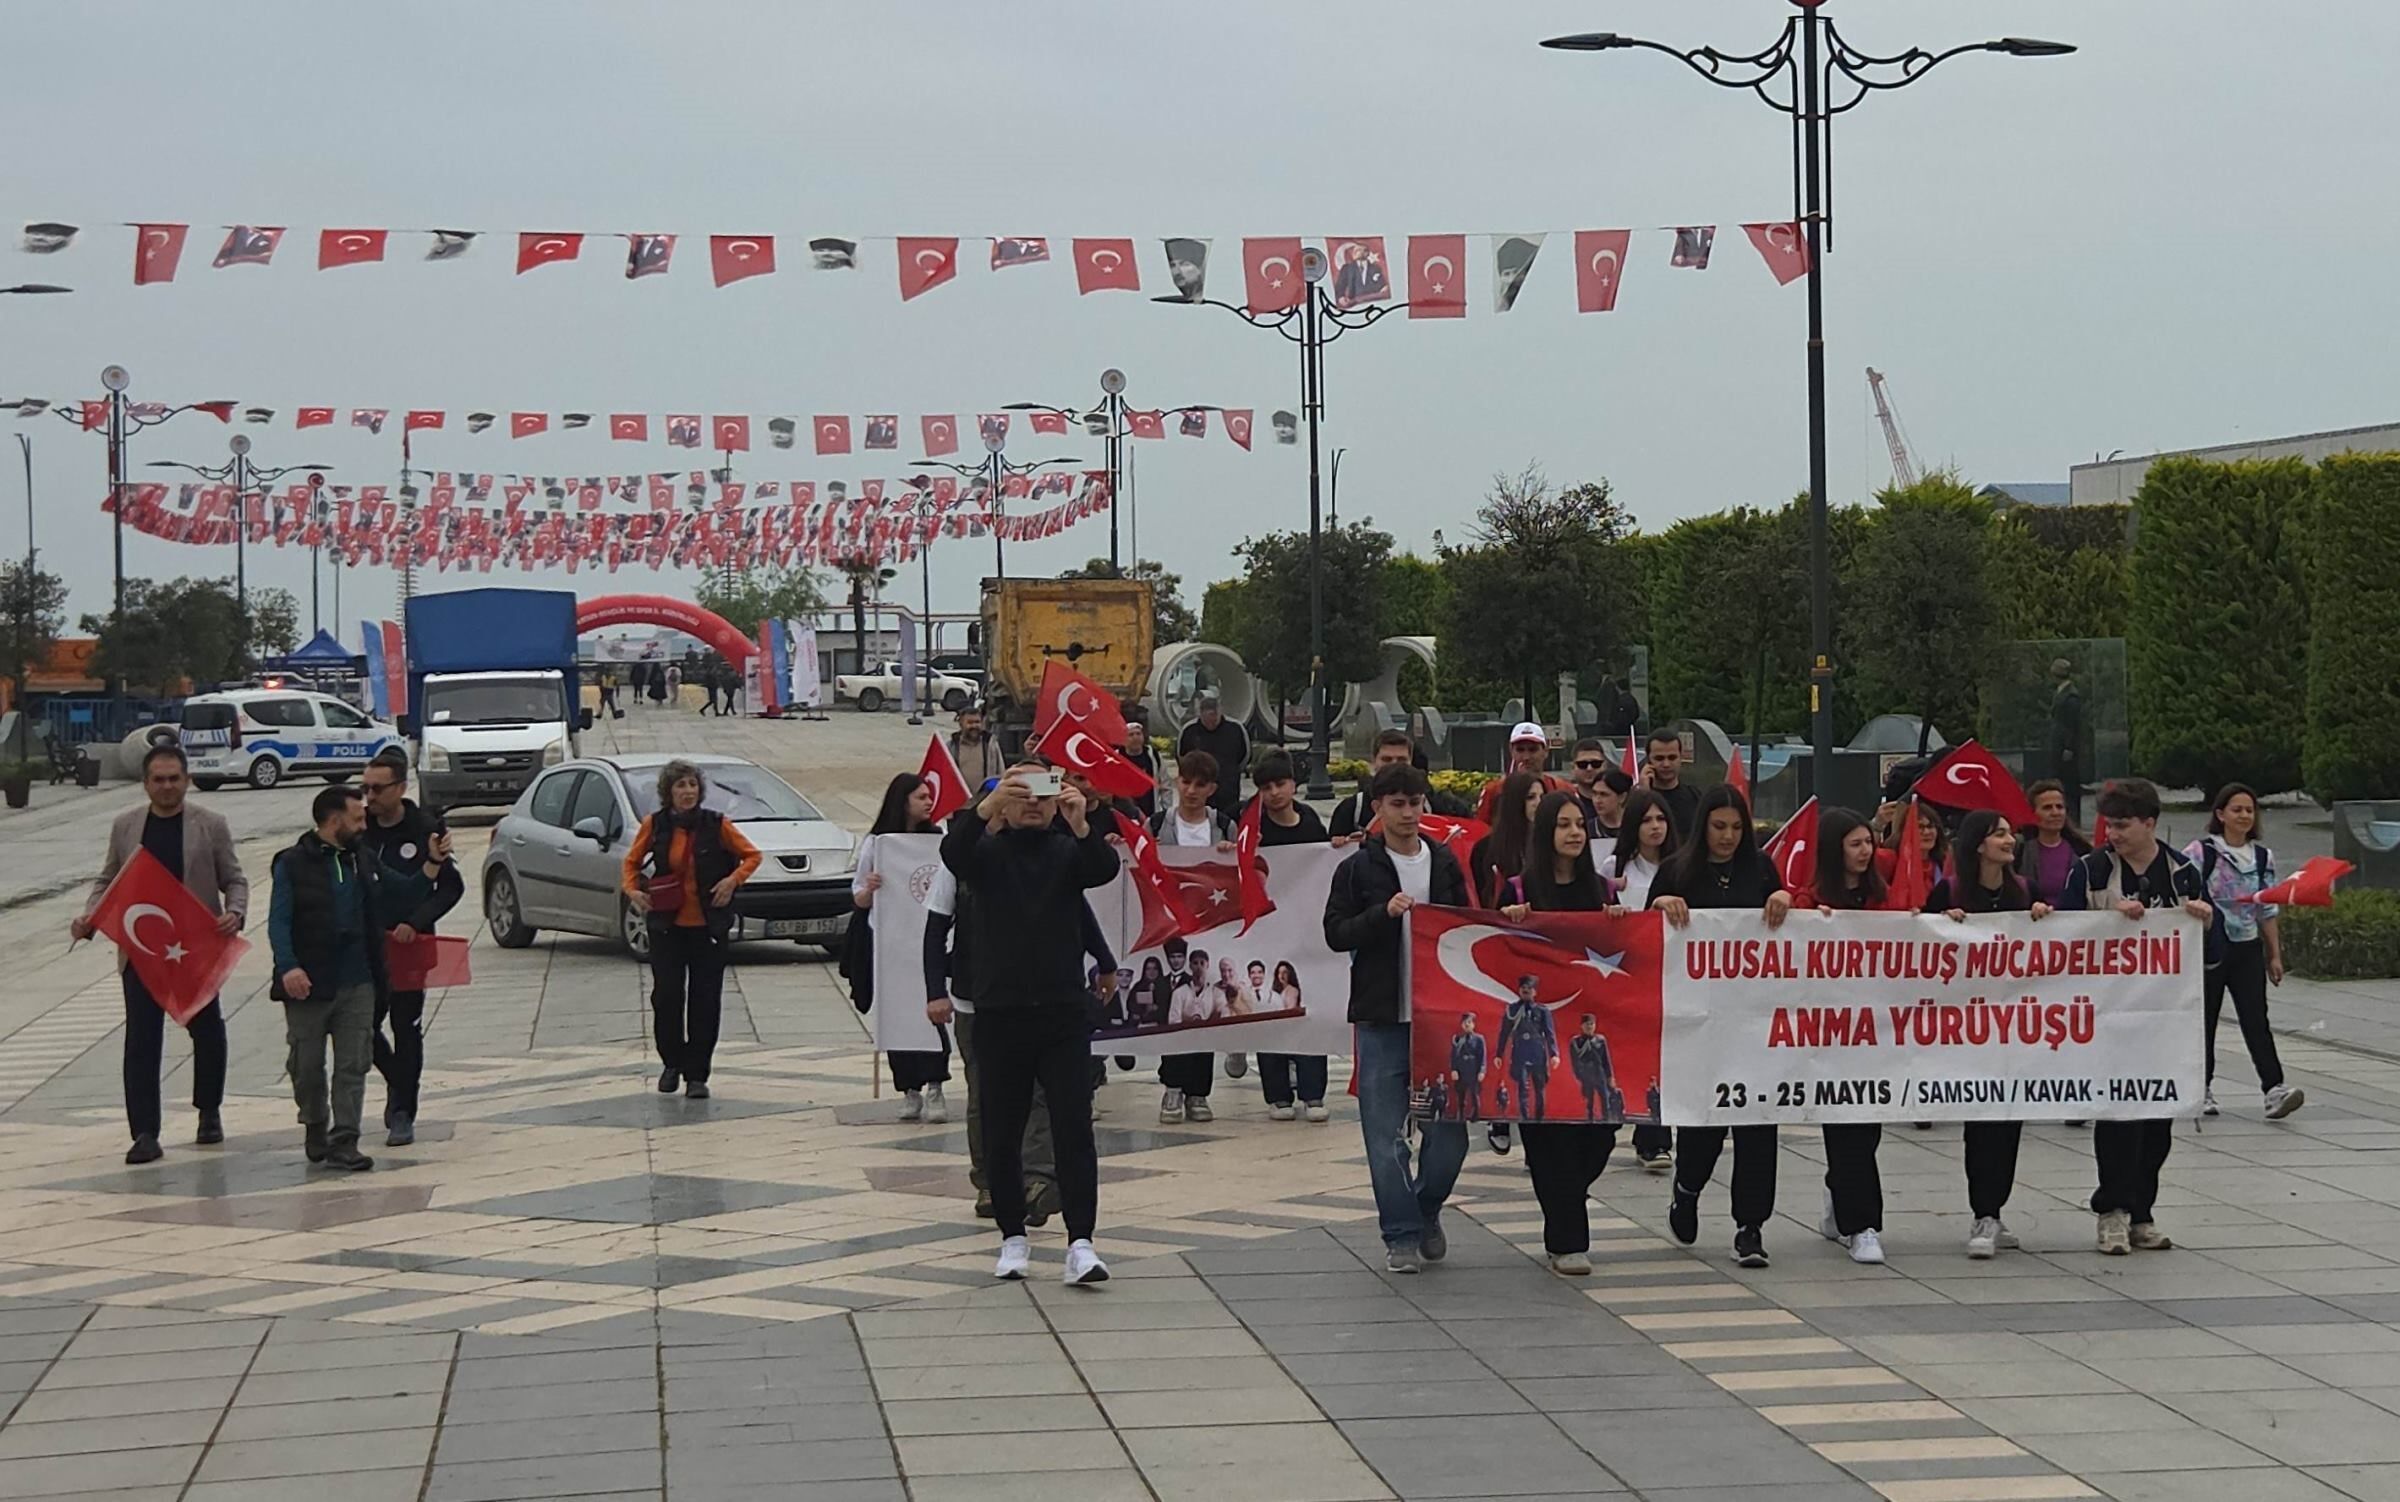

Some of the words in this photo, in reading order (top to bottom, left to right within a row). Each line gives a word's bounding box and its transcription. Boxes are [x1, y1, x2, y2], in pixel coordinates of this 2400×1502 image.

[332, 743, 368, 756] POLİS
[1686, 940, 1798, 980] ULUSAL
[1806, 940, 1959, 985] KURTULUŞ
[1965, 929, 2181, 979] MÜCADELESİNİ
[1767, 1006, 1878, 1048] ANMA
[1889, 995, 2095, 1052] YÜRÜYÜŞÜ
[1715, 1082, 1747, 1108] 23
[1776, 1081, 1806, 1107] 25
[1814, 1079, 1892, 1106] MAYIS
[1918, 1079, 2005, 1104] SAMSUN
[2024, 1078, 2092, 1101] KAVAK
[2109, 1078, 2179, 1101] HAVZA
